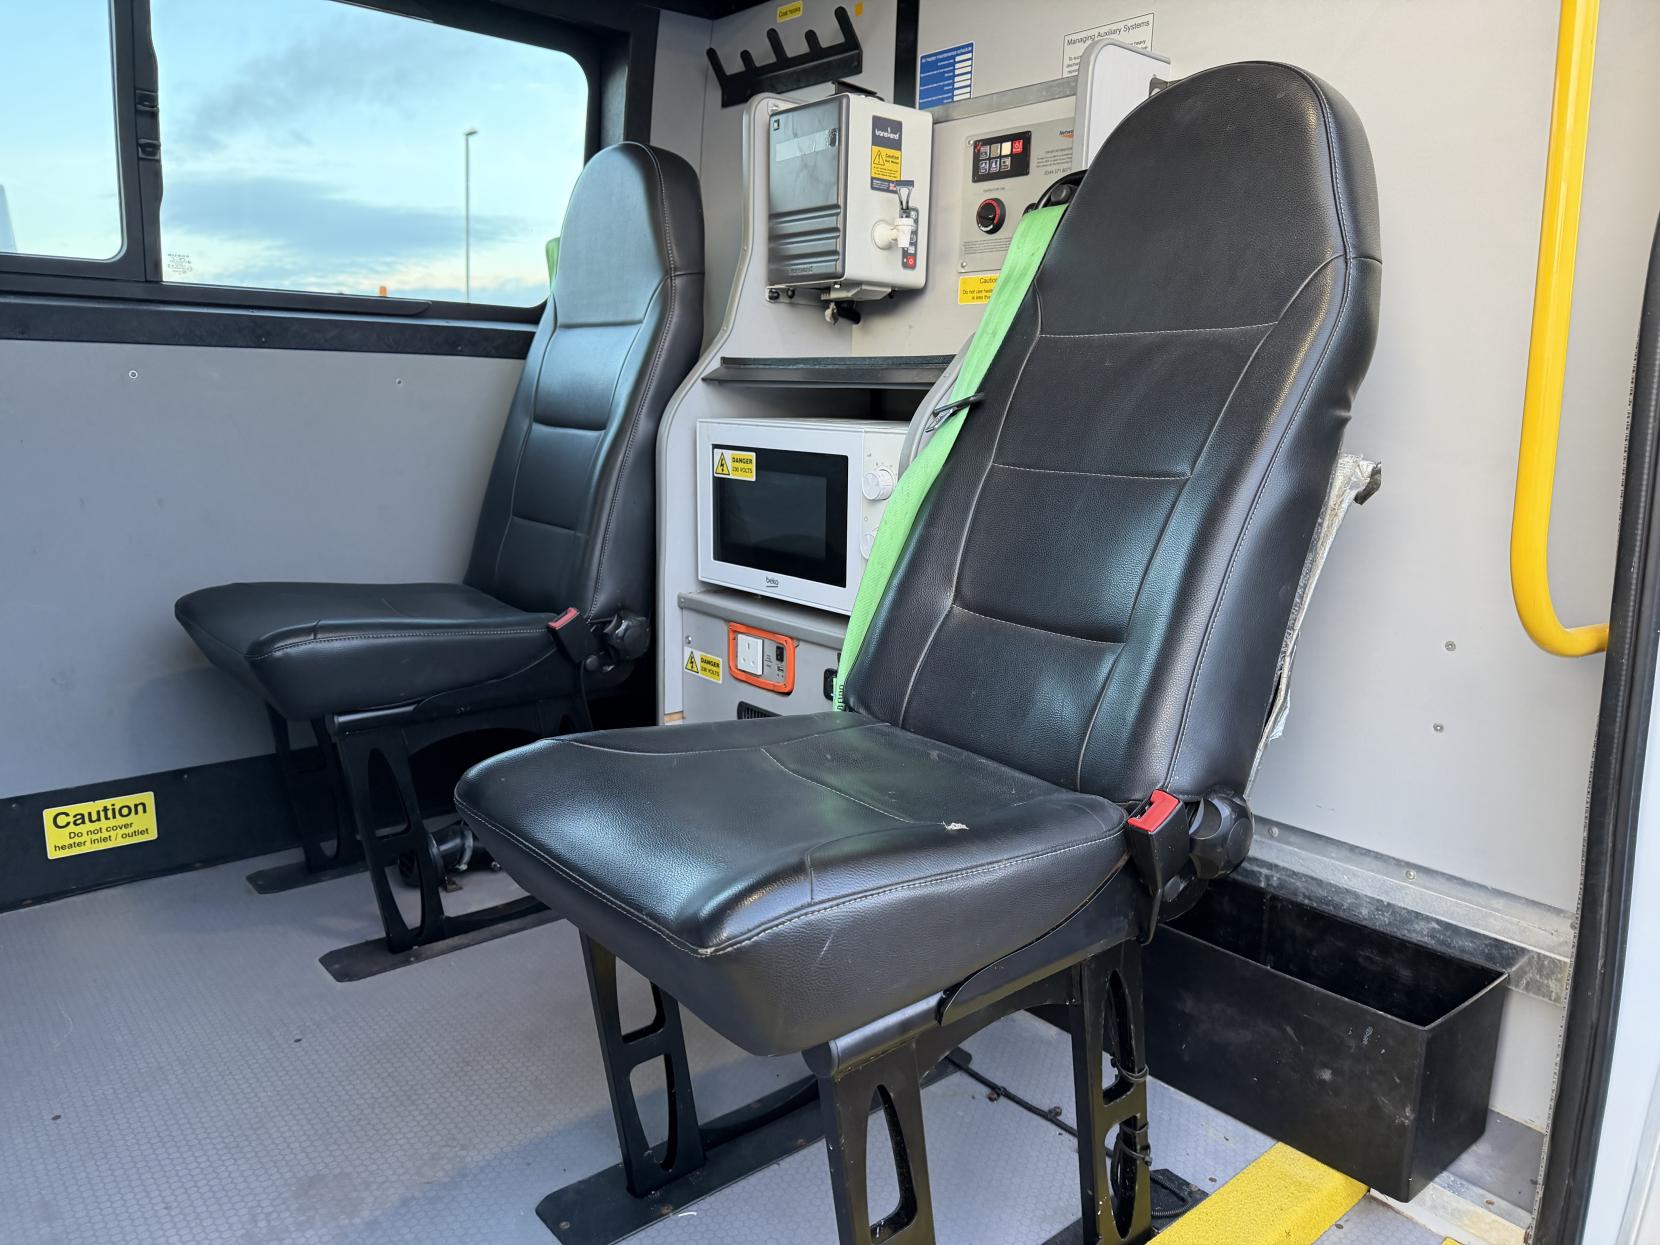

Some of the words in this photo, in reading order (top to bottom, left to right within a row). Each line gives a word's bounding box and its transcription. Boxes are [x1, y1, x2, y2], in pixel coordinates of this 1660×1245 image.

[1066, 33, 1096, 46] Managing
[1097, 26, 1122, 39] Auxiliary
[1123, 20, 1150, 33] Systems
[732, 456, 753, 465] DANGER
[740, 466, 753, 474] VOLTS
[765, 576, 779, 586] beko
[700, 657, 720, 668] DANGER
[52, 801, 147, 830] Caution
[68, 831, 83, 840] Do
[86, 827, 103, 837] not
[105, 822, 134, 833] cover
[54, 840, 87, 852] heater
[89, 835, 112, 846] inlet
[121, 827, 149, 840] outlet
